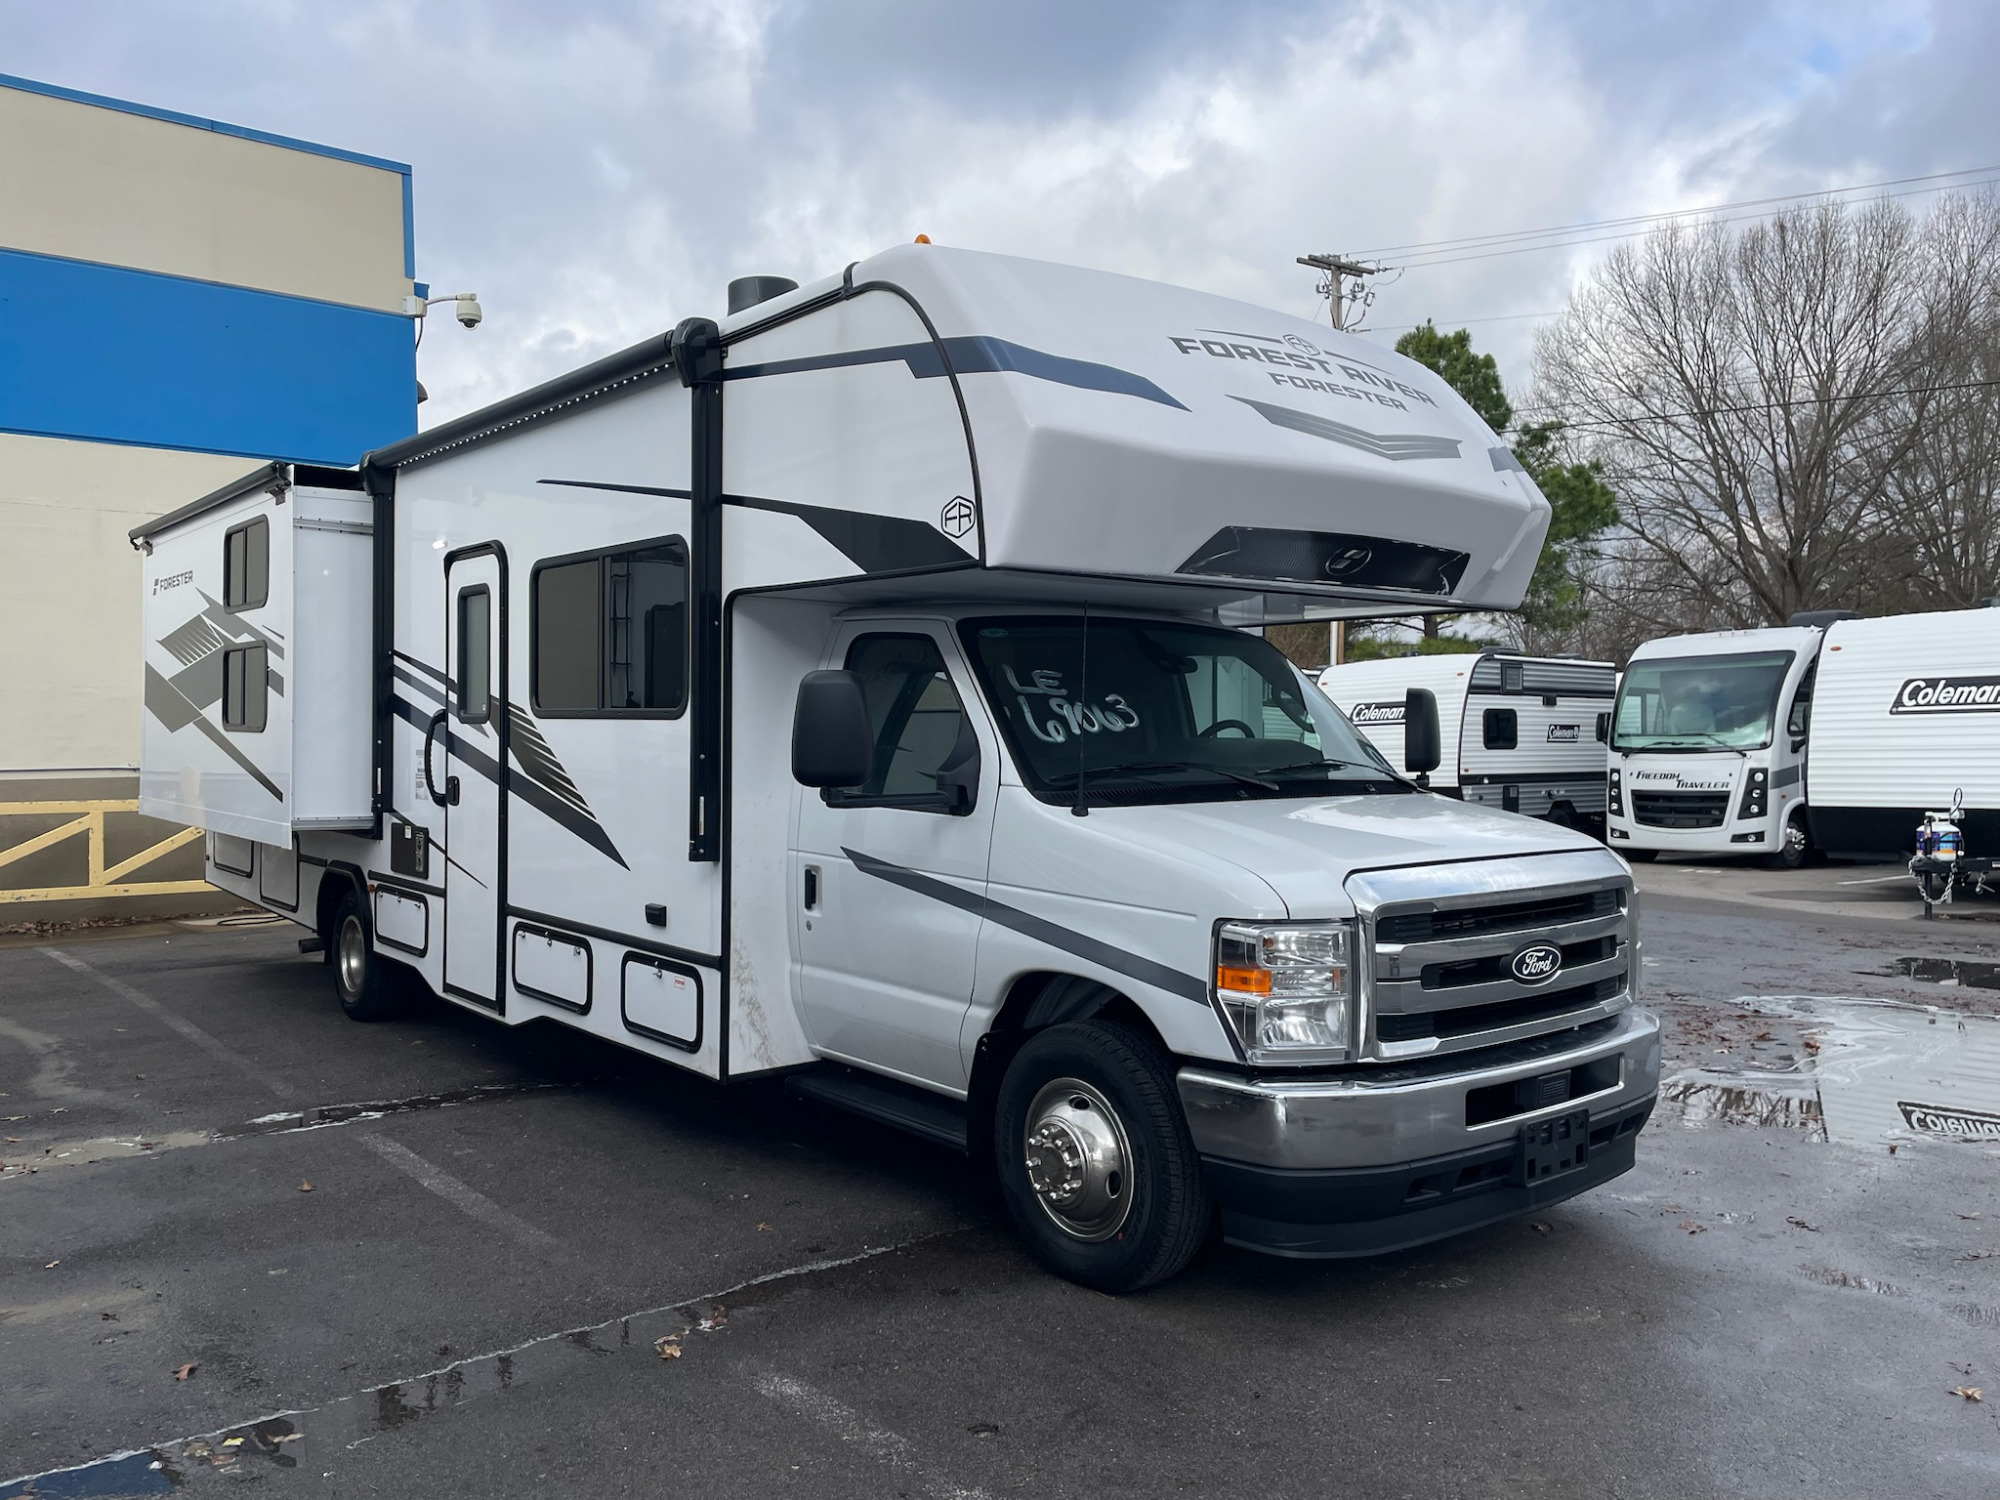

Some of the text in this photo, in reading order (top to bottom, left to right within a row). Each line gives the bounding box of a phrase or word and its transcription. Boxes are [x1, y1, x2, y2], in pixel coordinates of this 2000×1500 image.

[1168, 336, 1440, 409] FOREST RIVER
[1267, 372, 1410, 412] FORESTER
[160, 570, 194, 591] FORESTER
[1001, 663, 1069, 696] LE
[1352, 703, 1406, 722] Coleman
[1522, 951, 1553, 975] Ford
